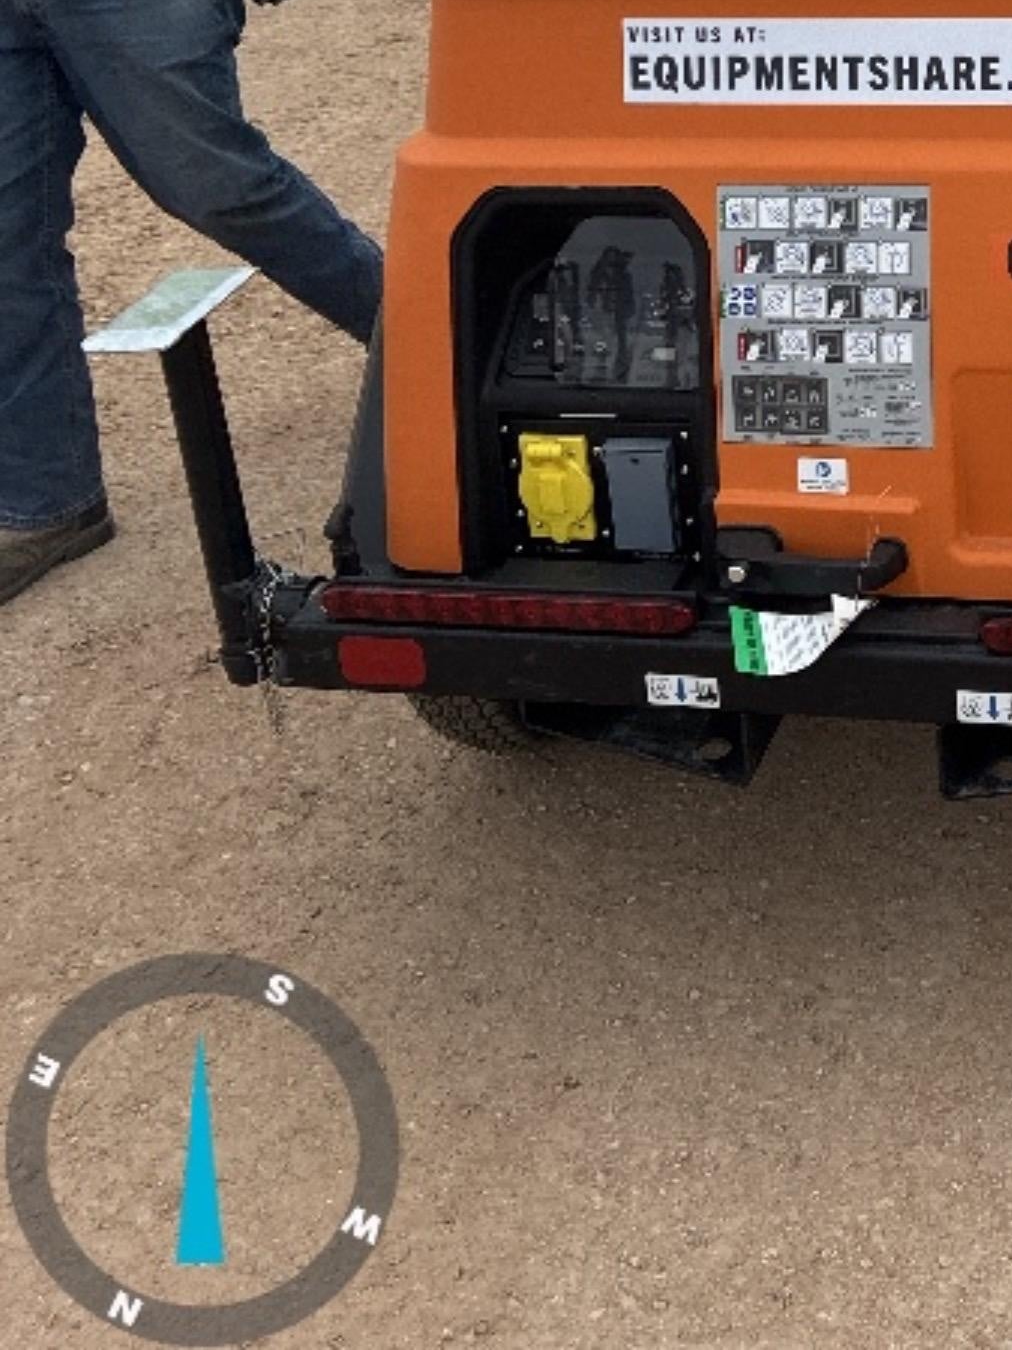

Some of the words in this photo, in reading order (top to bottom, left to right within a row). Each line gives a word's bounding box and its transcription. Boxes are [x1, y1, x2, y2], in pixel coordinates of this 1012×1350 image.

[626, 26, 686, 43] VISIT
[694, 26, 722, 43] US
[733, 26, 766, 43] AT:
